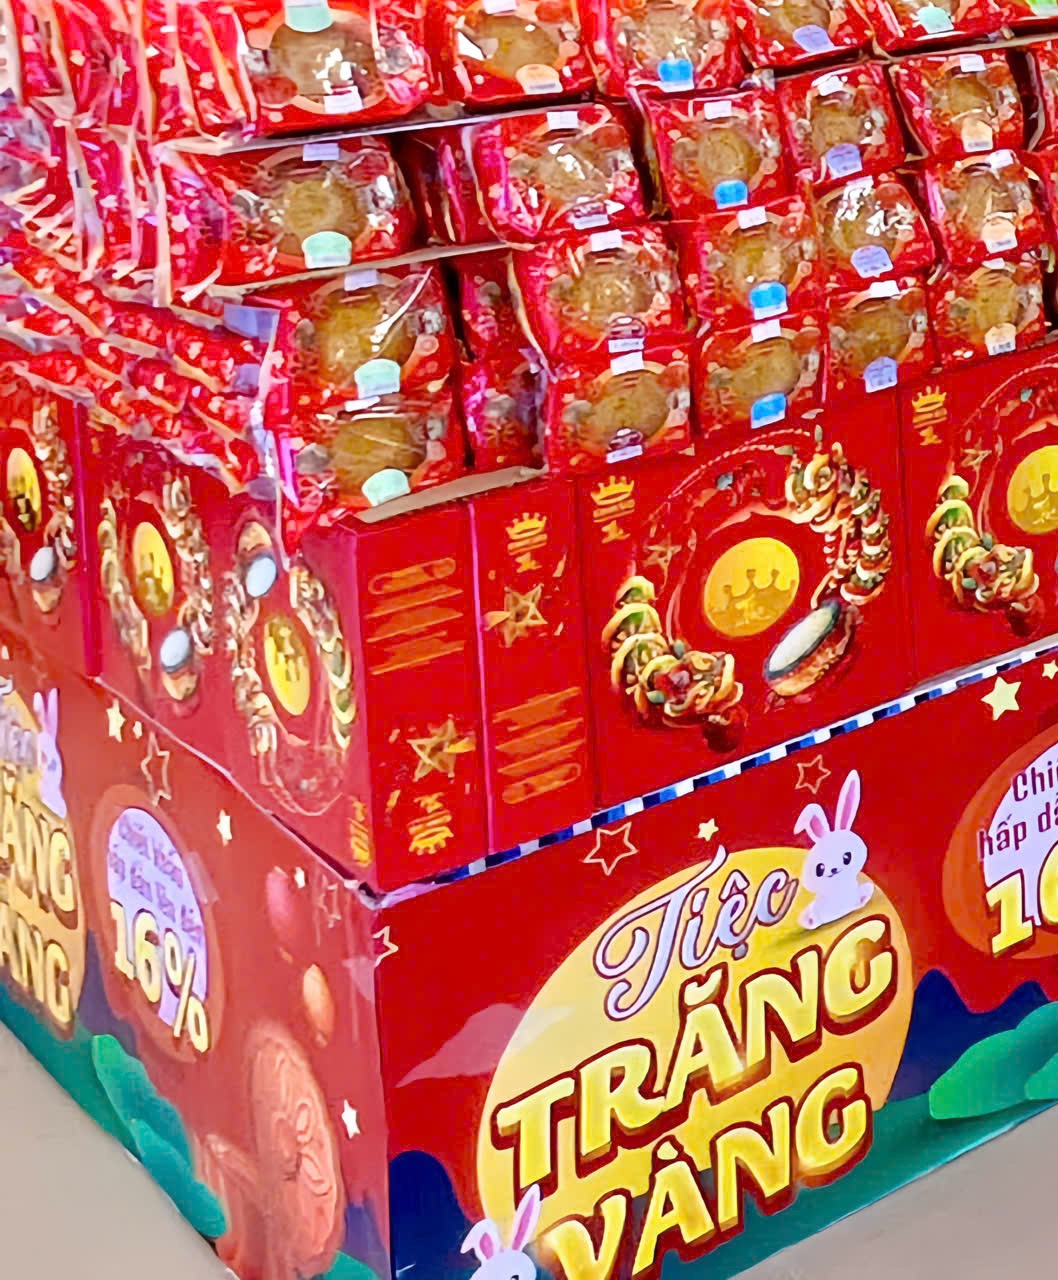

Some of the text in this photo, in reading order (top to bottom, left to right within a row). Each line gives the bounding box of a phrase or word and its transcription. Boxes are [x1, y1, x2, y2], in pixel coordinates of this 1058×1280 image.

[977, 813, 1028, 860] hấp
[110, 900, 209, 1052] 16%
[594, 845, 799, 1021] Tiệc
[493, 916, 896, 1198] TRĂNG
[542, 1063, 871, 1280] VÀNG
